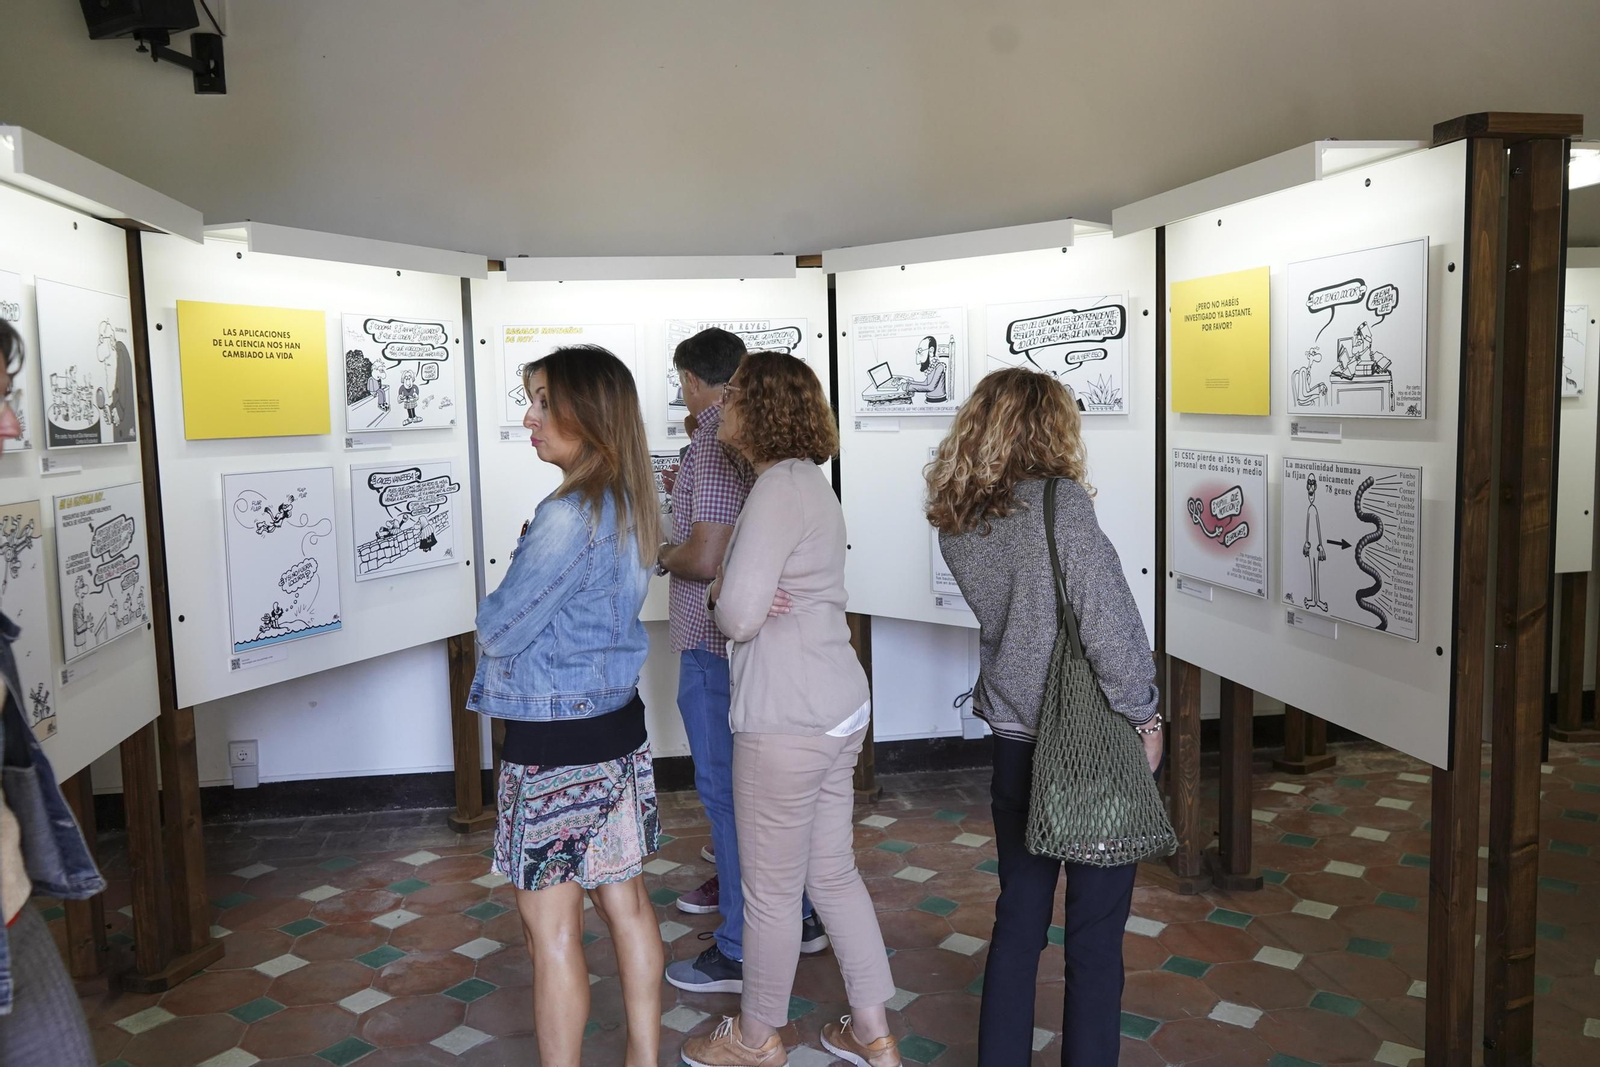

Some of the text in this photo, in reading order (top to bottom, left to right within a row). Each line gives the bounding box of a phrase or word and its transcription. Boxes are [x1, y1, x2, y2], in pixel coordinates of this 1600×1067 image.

[1196, 296, 1239, 312] ¿PERO NO HABÉIS
[1184, 312, 1216, 322] INVESTIGADO
[1225, 308, 1252, 318] BASTANTE,
[1013, 323, 1027, 332] ESTO
[1038, 318, 1062, 328] GENOMA
[1036, 327, 1047, 336] QUE
[1048, 326, 1060, 334] UNA
[1060, 322, 1084, 332] CEBOLLA
[1085, 320, 1102, 329] TIENE
[1202, 322, 1232, 332] POR FAVOR?
[239, 329, 291, 339] APLICACIONES
[1070, 330, 1080, 339] QUE
[236, 340, 265, 348] CIENCIA
[222, 350, 264, 359] CAMBIADO
[1182, 452, 1195, 460] CSIC
[1197, 453, 1216, 462] pierde
[1227, 456, 1241, 465] 15%
[1175, 461, 1197, 469] personal
[1208, 463, 1218, 471] dos
[1220, 465, 1235, 473] años
[1242, 468, 1262, 476] medio
[1286, 460, 1361, 474] La masculinidad humana
[1292, 471, 1306, 480] fijan
[1319, 473, 1354, 485] únicamente
[1325, 485, 1352, 496] 78 genes
[1401, 495, 1414, 504] Orsay
[1397, 532, 1414, 542] Penalty
[1393, 569, 1414, 578] Chorizos
[1391, 576, 1414, 586] Trincones
[1394, 584, 1413, 593] Extremo
[1400, 593, 1413, 601] banda
[1394, 599, 1413, 608] Paradón
[1394, 614, 1413, 624] Cantada
